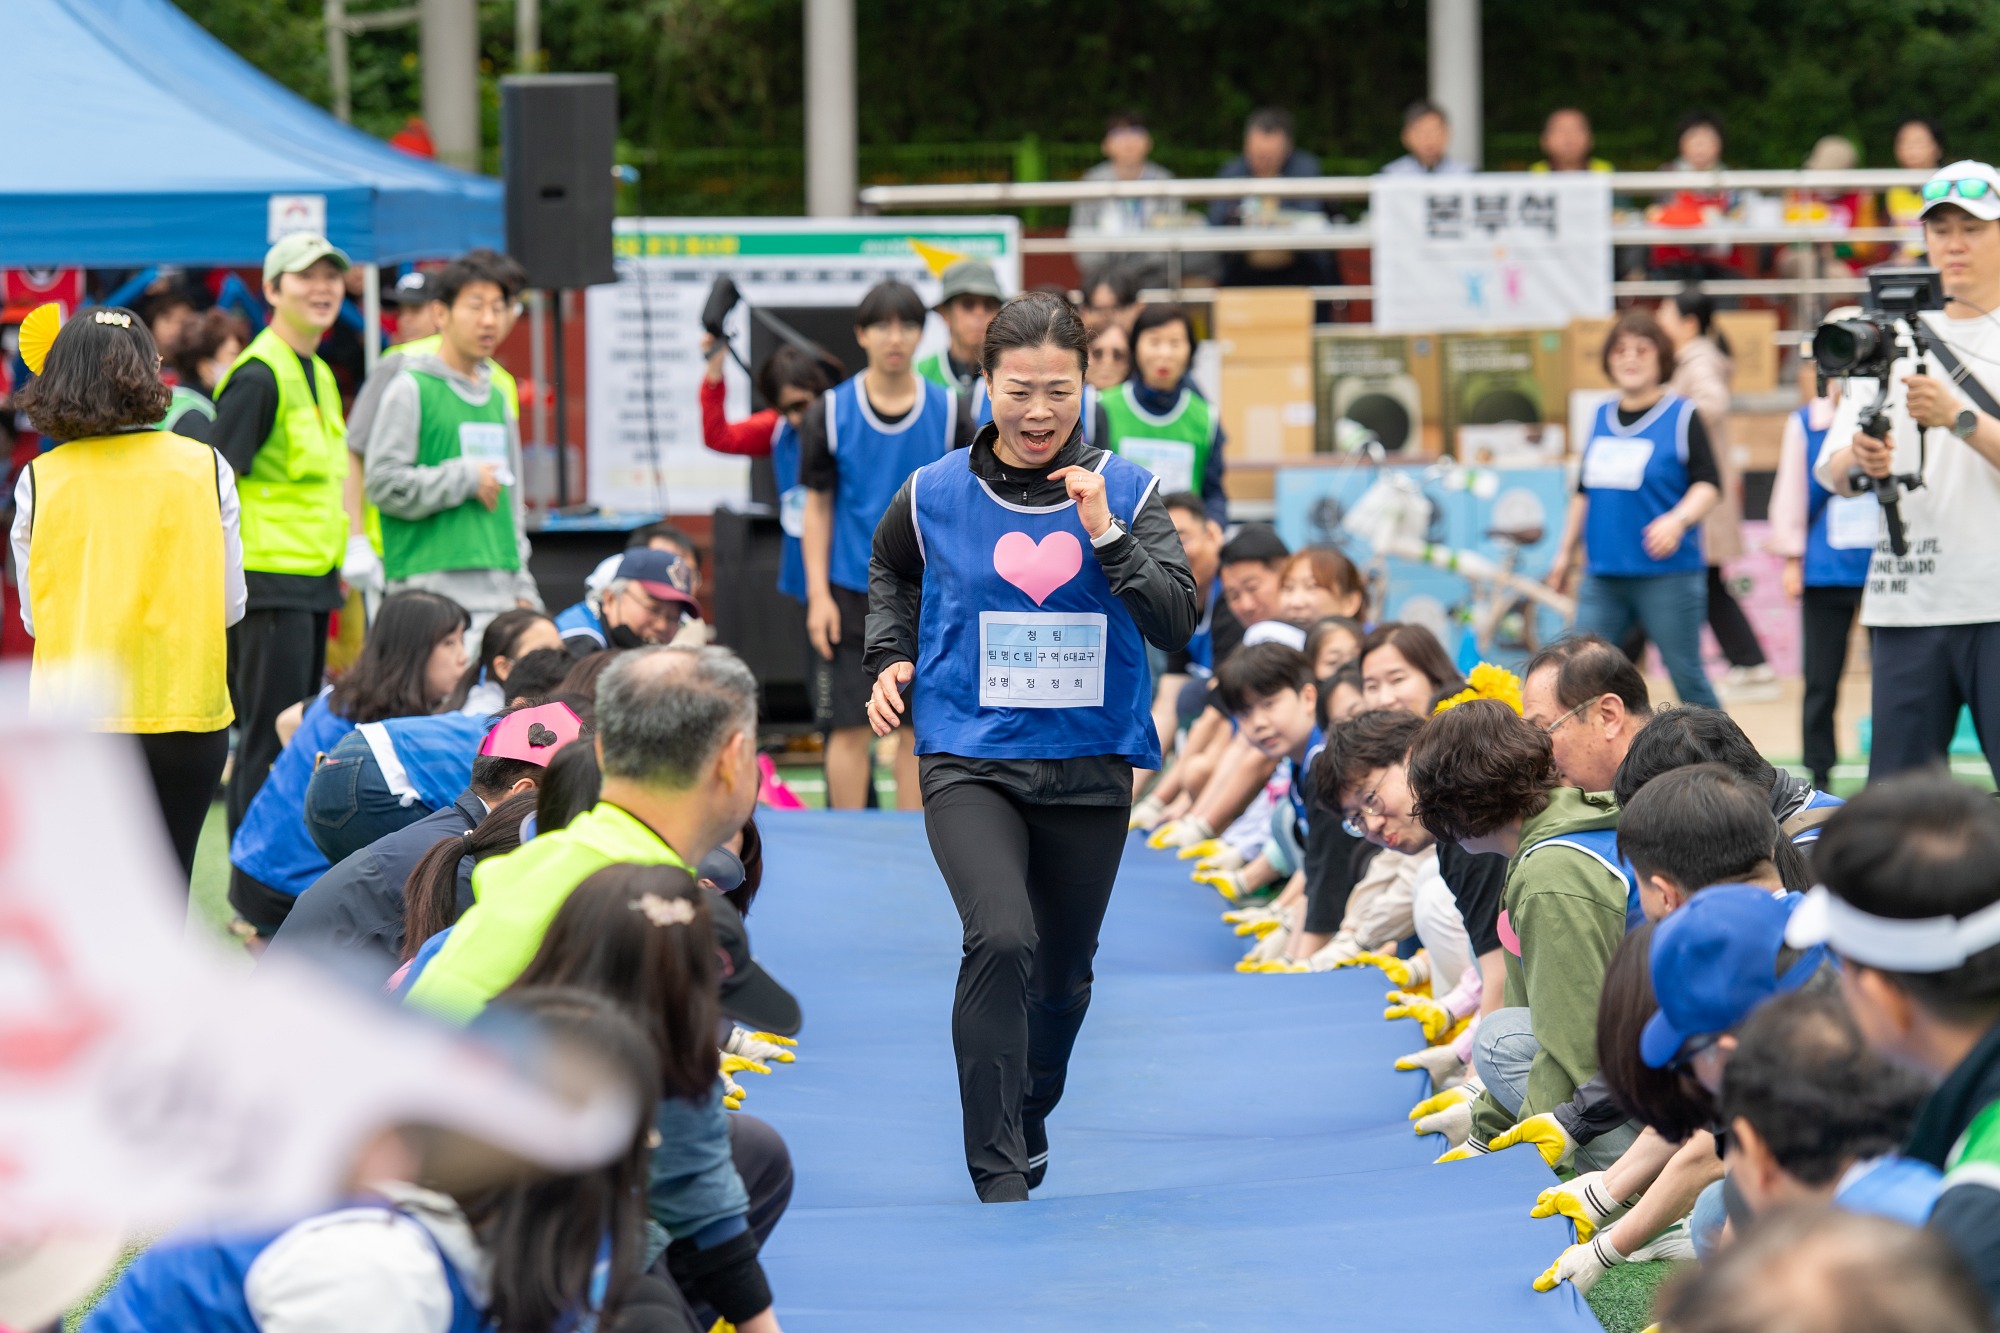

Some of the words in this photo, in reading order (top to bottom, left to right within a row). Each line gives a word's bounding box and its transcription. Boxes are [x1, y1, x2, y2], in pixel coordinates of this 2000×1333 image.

[1427, 192, 1558, 239] 본부석
[1919, 557, 1936, 574] DO
[1870, 579, 1886, 594] FOR
[1891, 579, 1908, 594] ME
[1027, 630, 1037, 641] 청
[1052, 630, 1062, 641] 팀
[988, 650, 997, 660] 팀
[1013, 653, 1020, 661] C
[1024, 652, 1032, 662] 팀
[1038, 653, 1046, 662] 구
[1051, 652, 1059, 662] 역
[1063, 652, 1095, 662] 6대교구
[987, 676, 996, 687] 성
[1000, 677, 1009, 688] 명
[1026, 678, 1035, 689] 정
[1051, 678, 1060, 689] 정
[1074, 678, 1083, 689] 희
